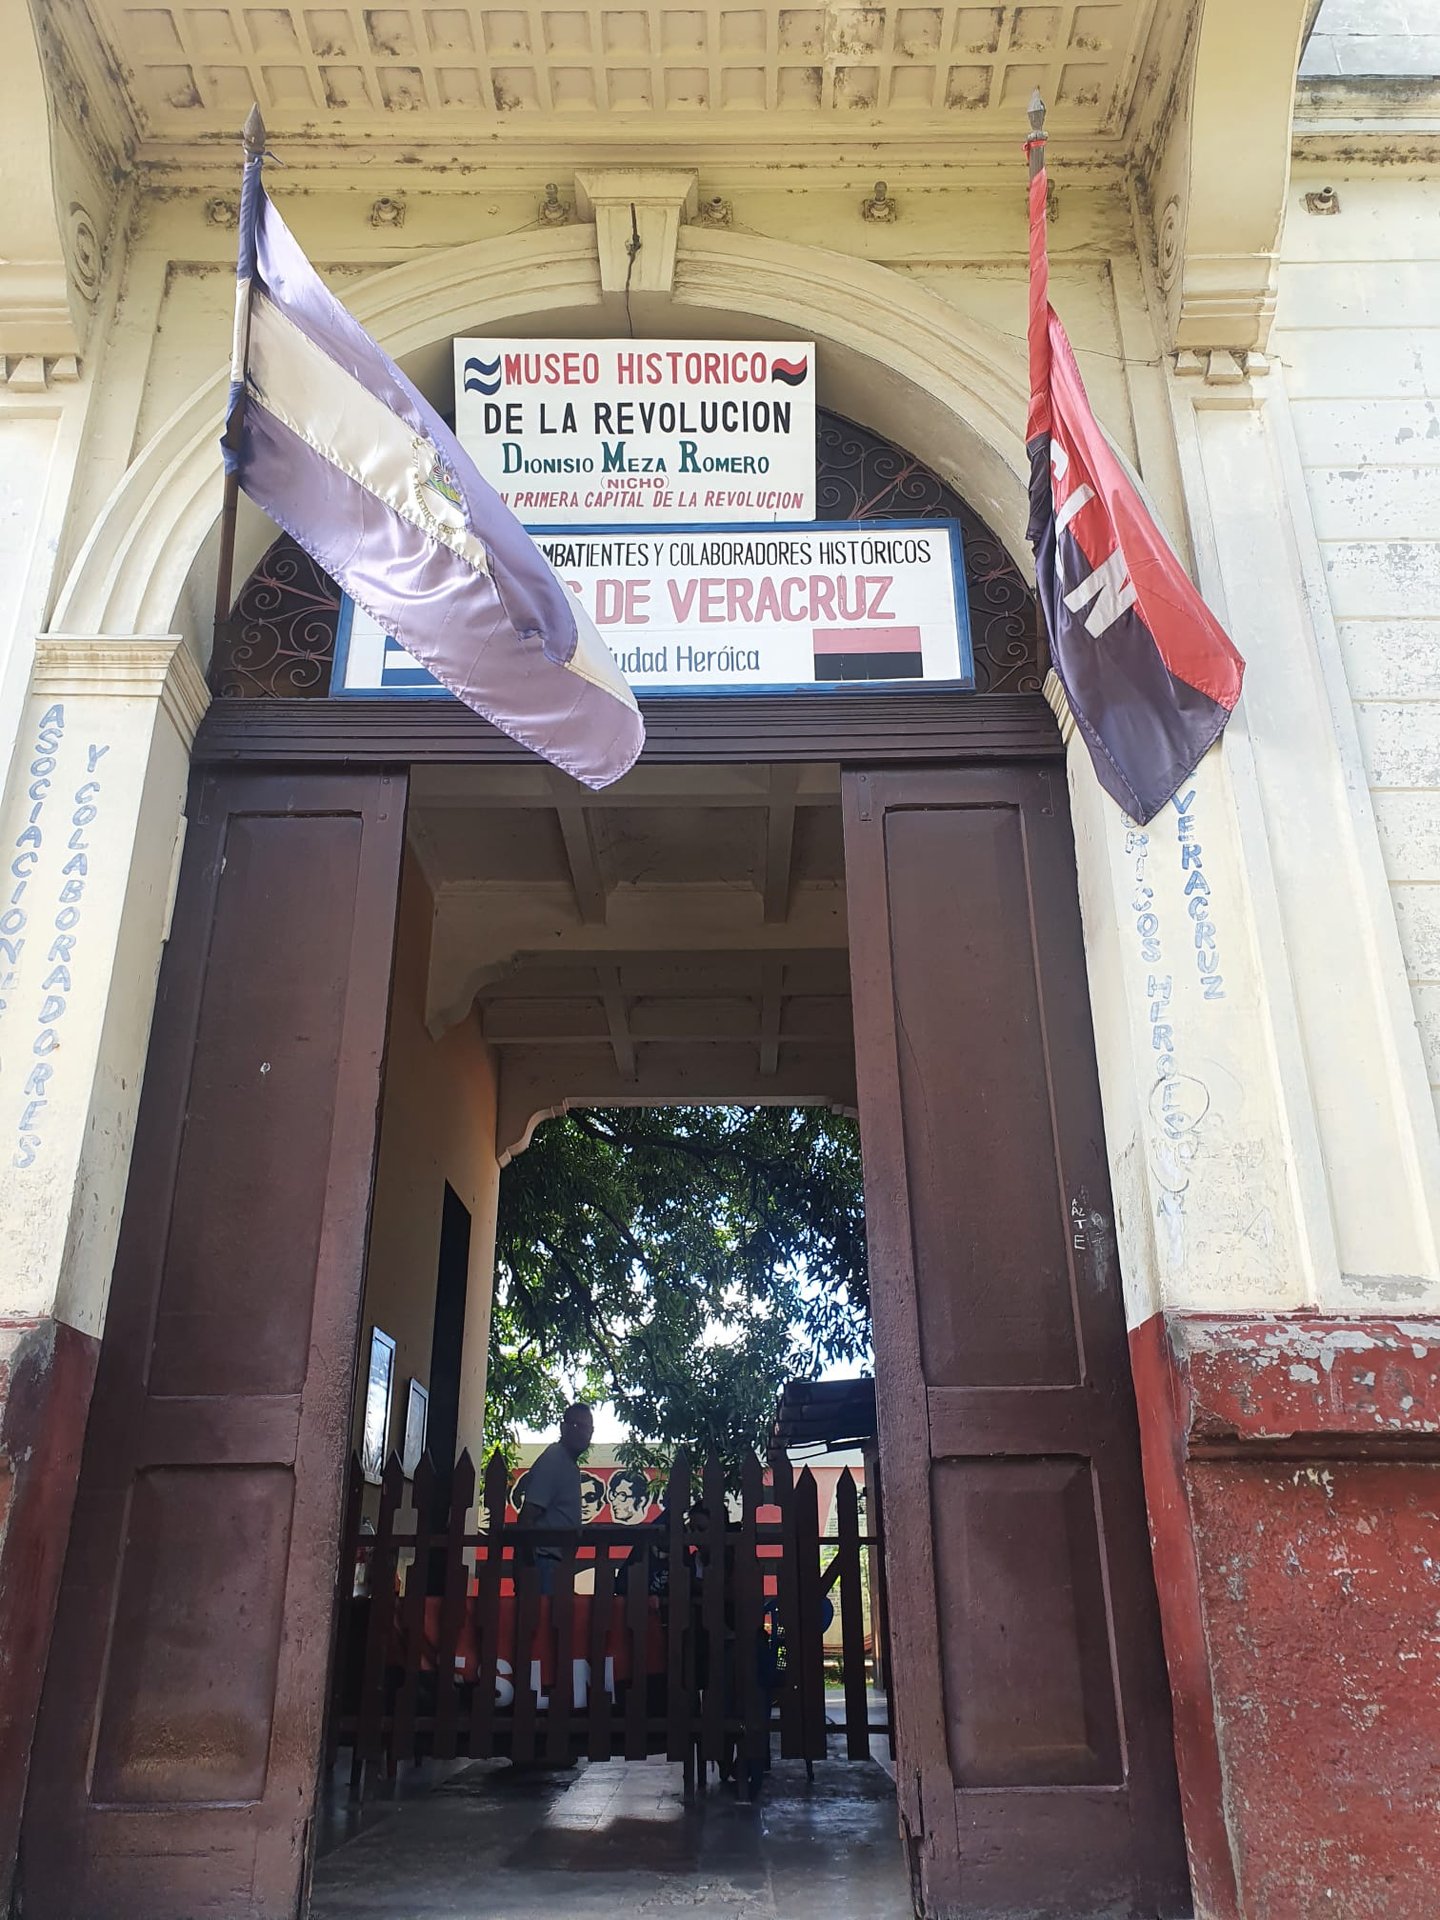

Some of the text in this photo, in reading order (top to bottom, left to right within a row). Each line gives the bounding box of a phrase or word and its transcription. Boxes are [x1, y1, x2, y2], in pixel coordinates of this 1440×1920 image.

[504, 352, 767, 385] MUSEO HISTORICO
[484, 401, 791, 434] DE LA REVOLUCION
[600, 476, 670, 489] (NICHO)
[513, 491, 579, 508] PRIMERA
[584, 490, 645, 508] CAPITAL
[653, 491, 674, 508] DE
[678, 491, 697, 508] LA
[704, 491, 804, 509] REVOLUCION
[539, 537, 931, 567] MBATIENTES Y COLABORADORES HISTÓRICOS
[595, 575, 896, 625] DE VERACRUZ
[676, 645, 760, 672] Heróica
[1171, 790, 1226, 1000] VERACRUZ
[12, 744, 110, 1168] Y COLABORADORES
